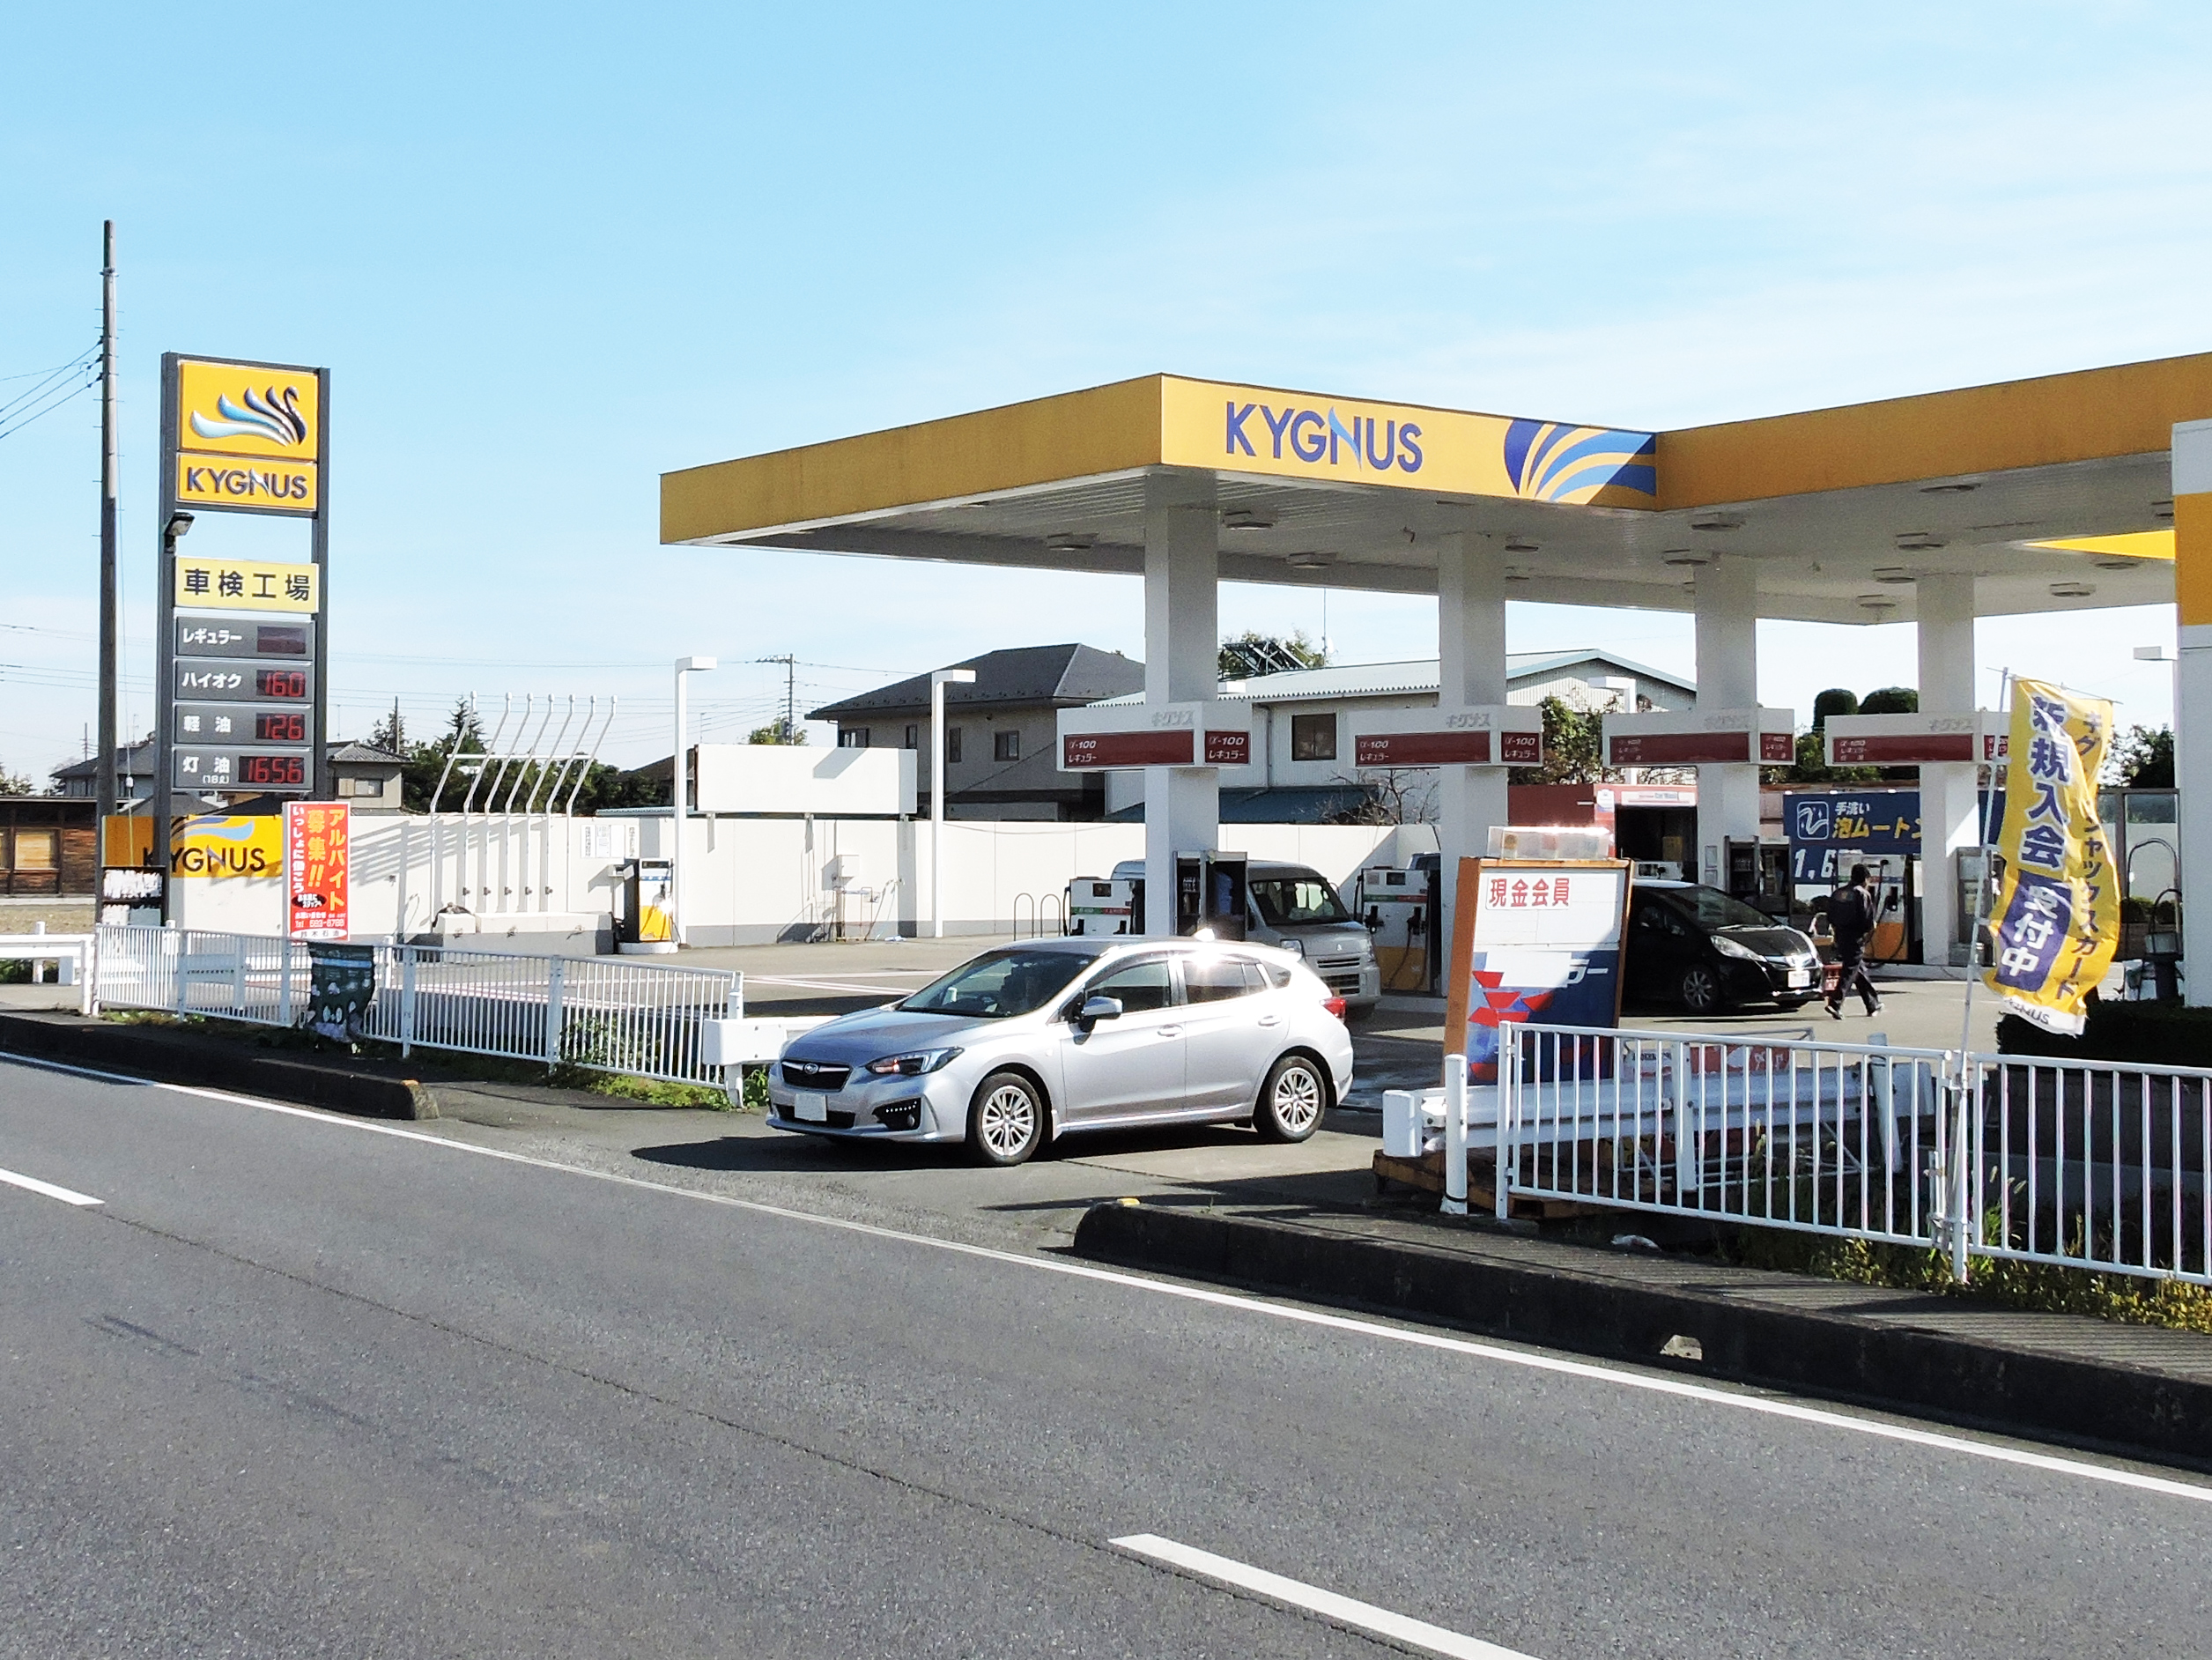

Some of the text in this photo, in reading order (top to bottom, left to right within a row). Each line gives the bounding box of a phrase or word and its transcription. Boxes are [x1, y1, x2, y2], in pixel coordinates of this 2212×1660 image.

[1226, 401, 1423, 473] KYGNUS
[186, 467, 307, 500] KYGNUS
[183, 568, 310, 602] 車検工場
[182, 628, 242, 644] レギュラー
[181, 671, 304, 697] ハイオク 160
[266, 715, 303, 740] 126
[182, 756, 303, 783] 灯油 1656
[2001, 696, 2069, 976] 新規入会 受付中
[328, 809, 347, 911] アルバイト
[1489, 878, 1571, 908] 現金会員
